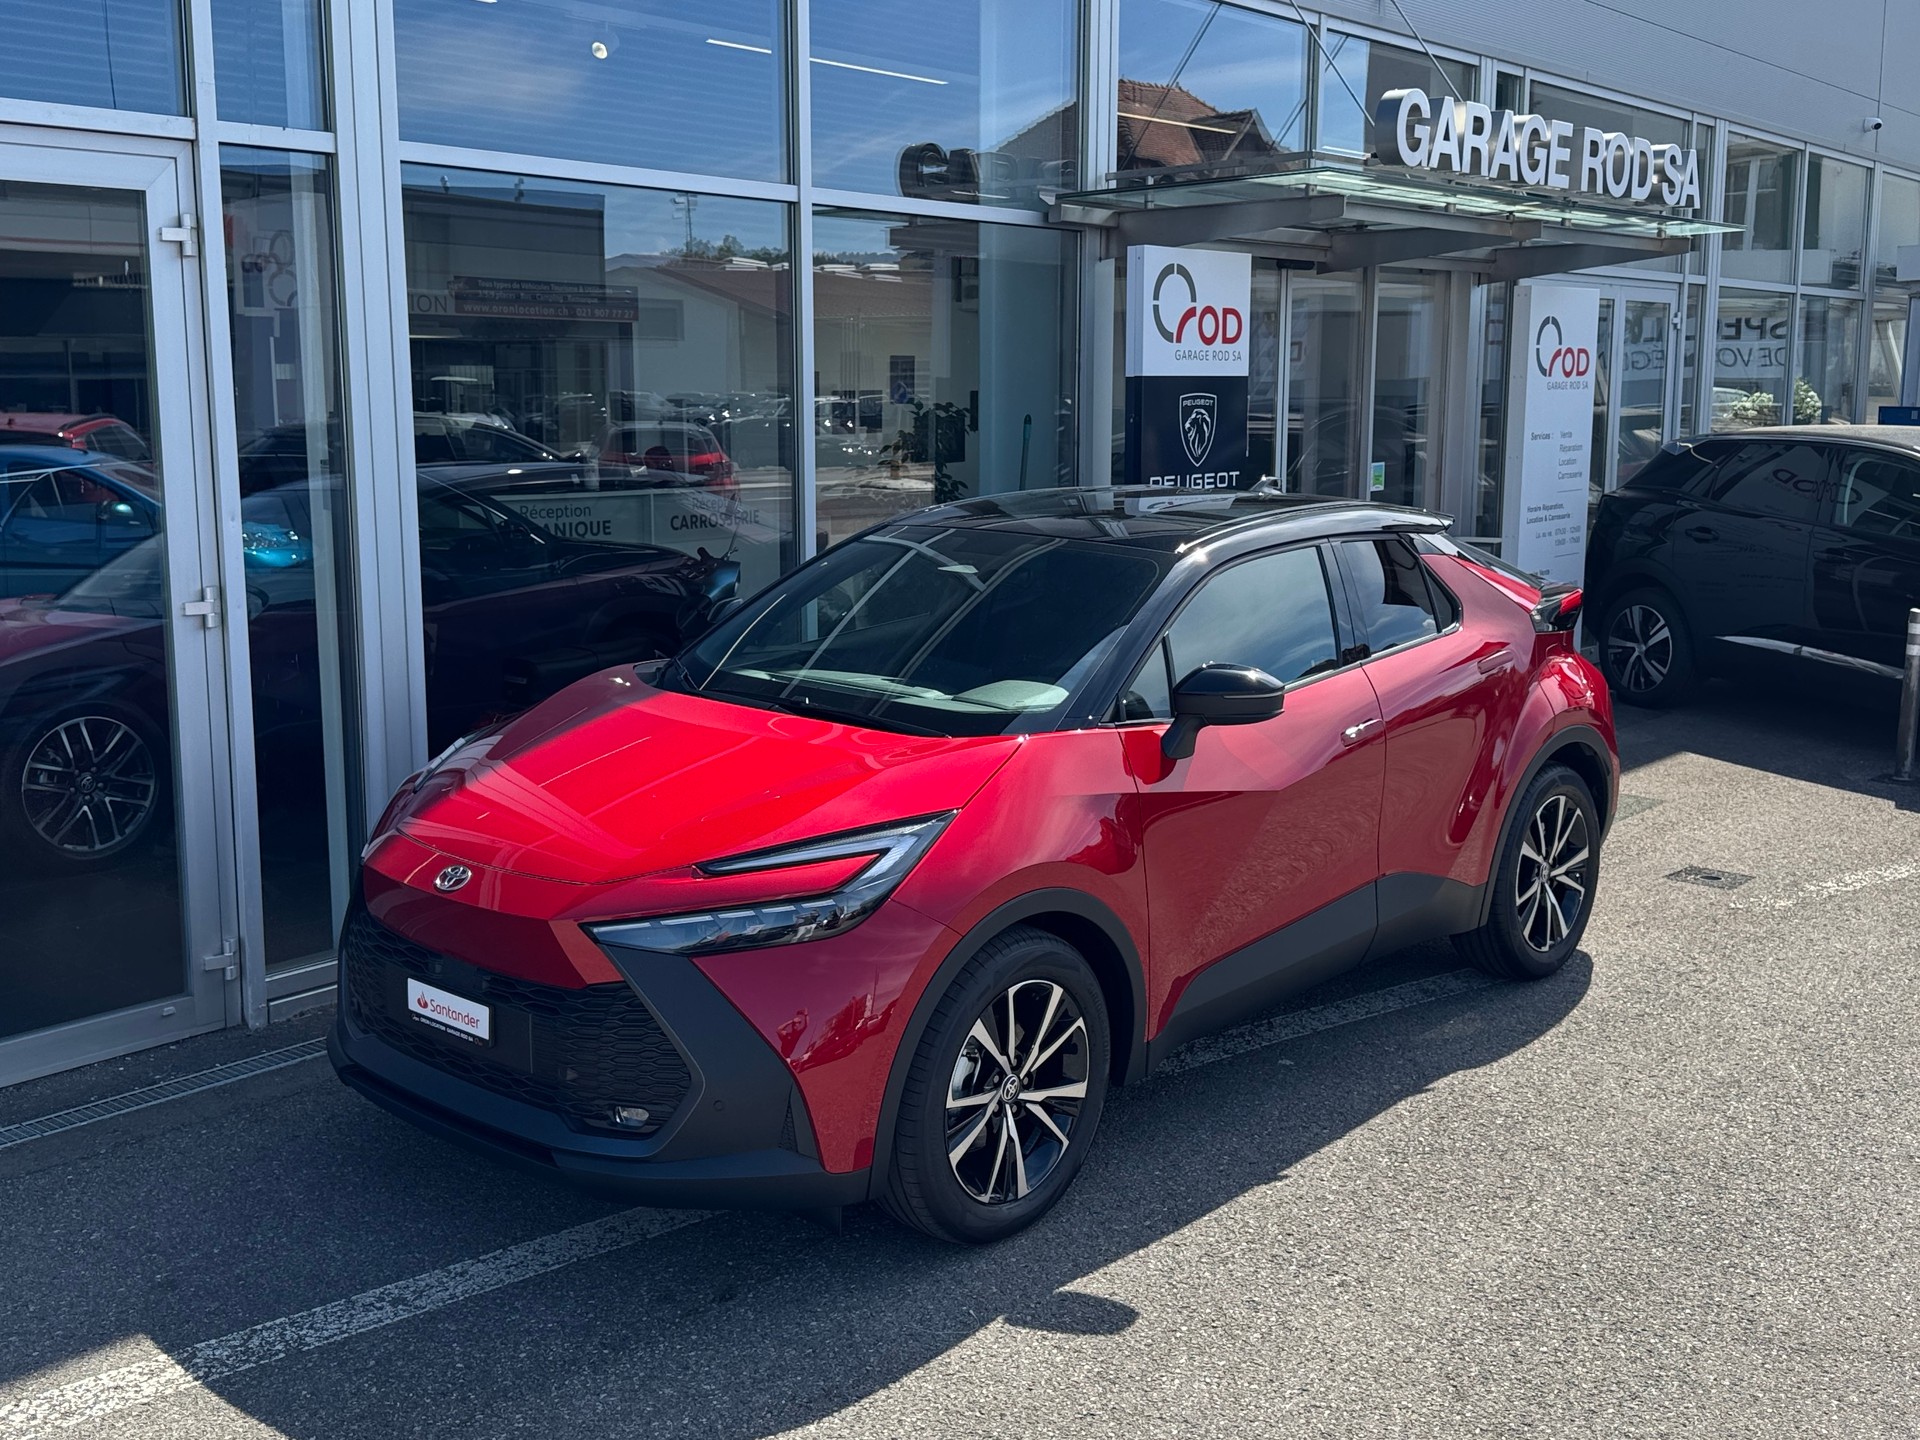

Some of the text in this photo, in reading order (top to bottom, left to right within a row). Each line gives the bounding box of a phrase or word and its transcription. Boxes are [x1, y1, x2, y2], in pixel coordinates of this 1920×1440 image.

[1396, 87, 1701, 210] GARAGE ROD SA
[463, 303, 569, 317] www.oronlocation.ch
[576, 308, 592, 317] 021
[593, 309, 609, 318] 907
[1174, 349, 1243, 362] GARAGE ROD SA
[1546, 380, 1589, 391] GARAGE ROD SA
[1182, 398, 1215, 407] PEUGEOT
[1530, 431, 1551, 441] Services
[519, 503, 592, 522] Réception
[429, 998, 480, 1029] Santander
